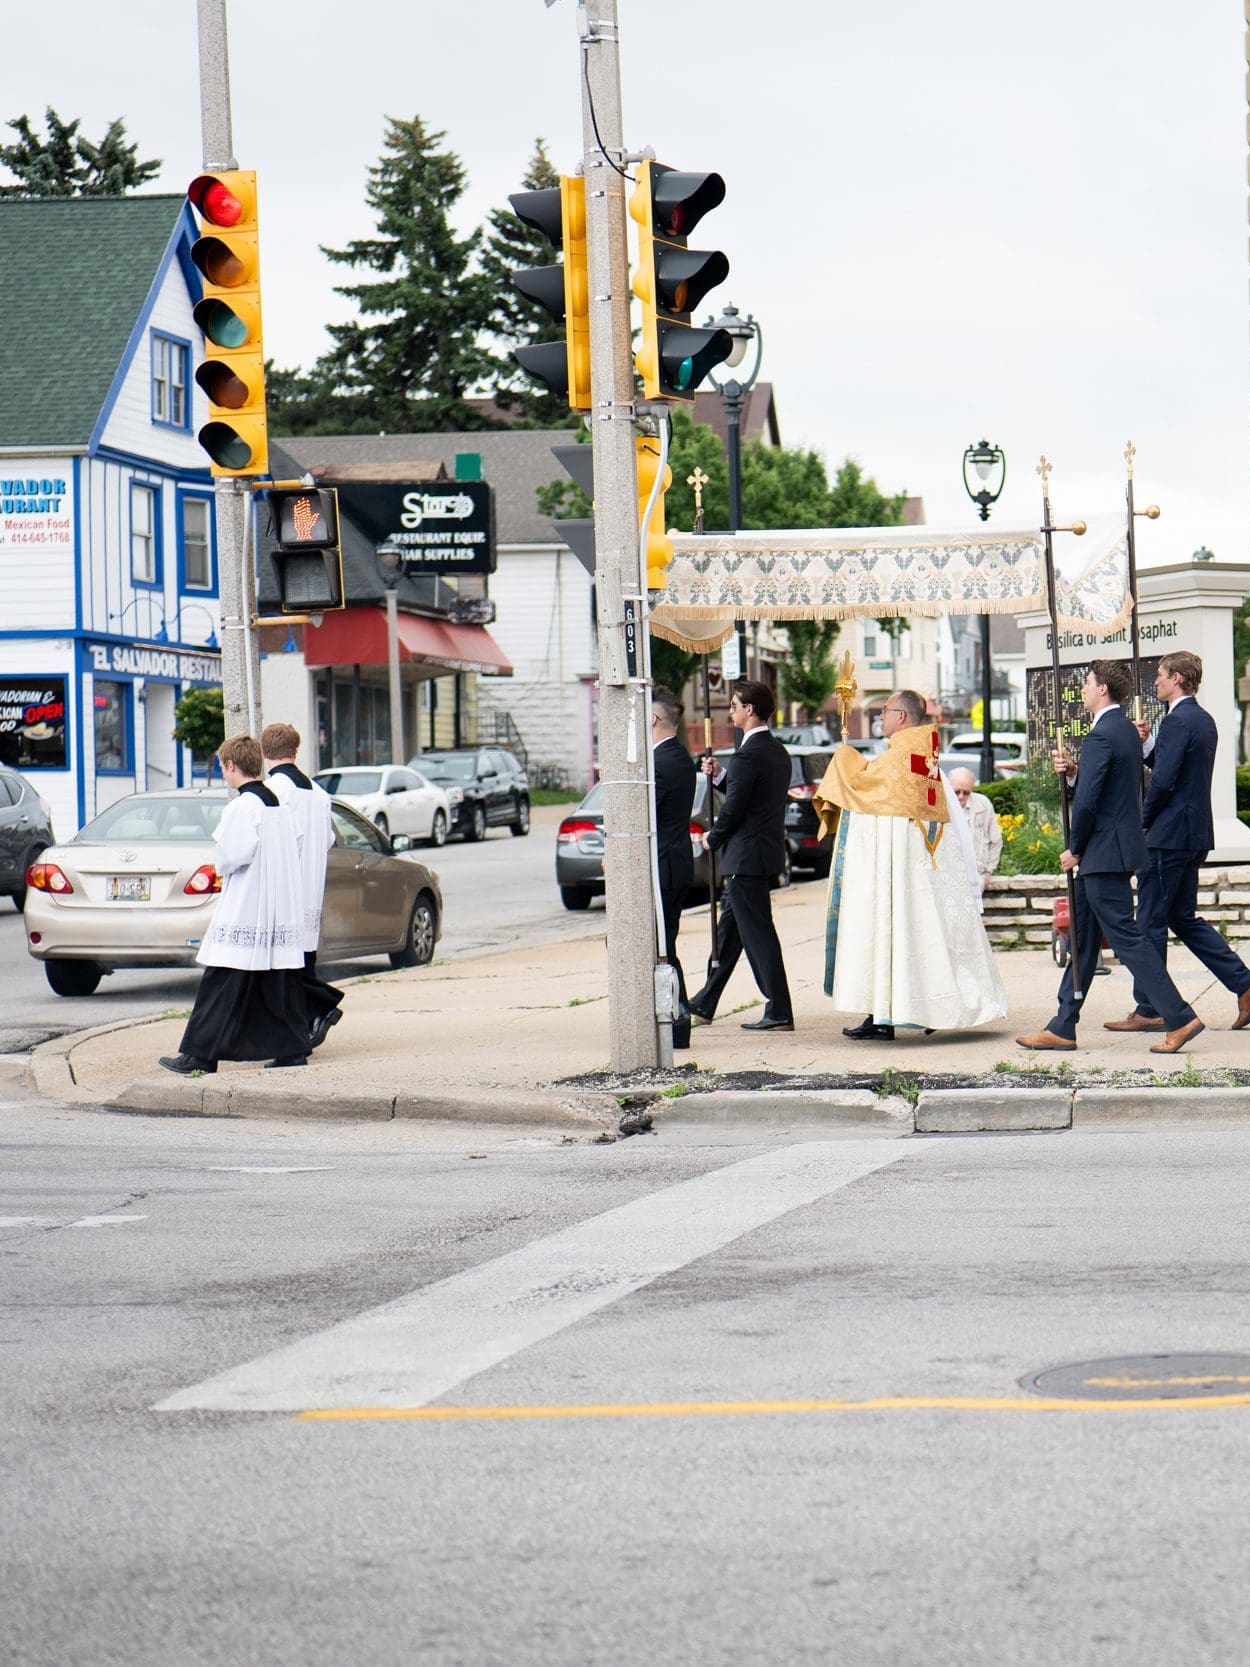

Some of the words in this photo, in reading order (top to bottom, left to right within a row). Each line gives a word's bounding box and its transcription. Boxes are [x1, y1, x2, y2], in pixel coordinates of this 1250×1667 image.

[0, 479, 66, 496] VADOR
[0, 498, 61, 514] URANT
[5, 519, 44, 529] Mexican
[47, 518, 70, 529] Food
[424, 549, 475, 561] SUPPLIES
[1047, 630, 1084, 650] Bsilica
[1128, 619, 1178, 645] Jsaphat
[89, 645, 112, 671] EL
[112, 646, 178, 678] SALVADOR
[25, 702, 64, 724] OPEN
